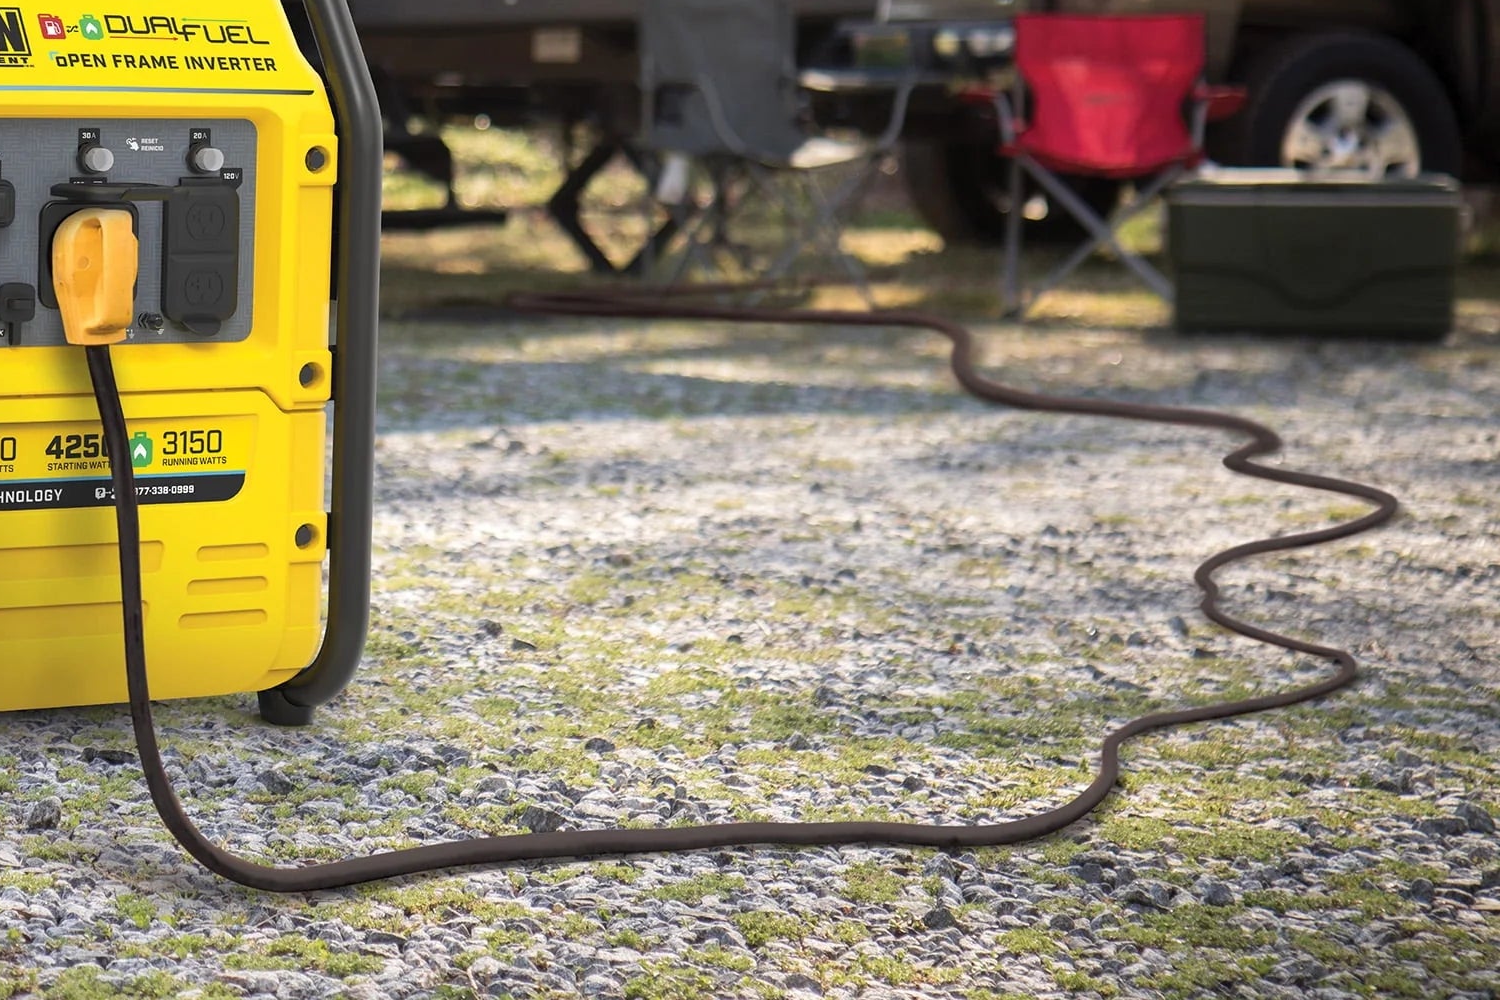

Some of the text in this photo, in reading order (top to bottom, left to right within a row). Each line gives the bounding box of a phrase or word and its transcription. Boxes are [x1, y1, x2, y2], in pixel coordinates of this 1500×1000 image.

[114, 54, 179, 70] FRAME
[186, 55, 278, 72] INVERTER
[162, 430, 223, 455] 3150
[47, 461, 88, 471] STARTING
[162, 455, 227, 466] RUNNING WATTS
